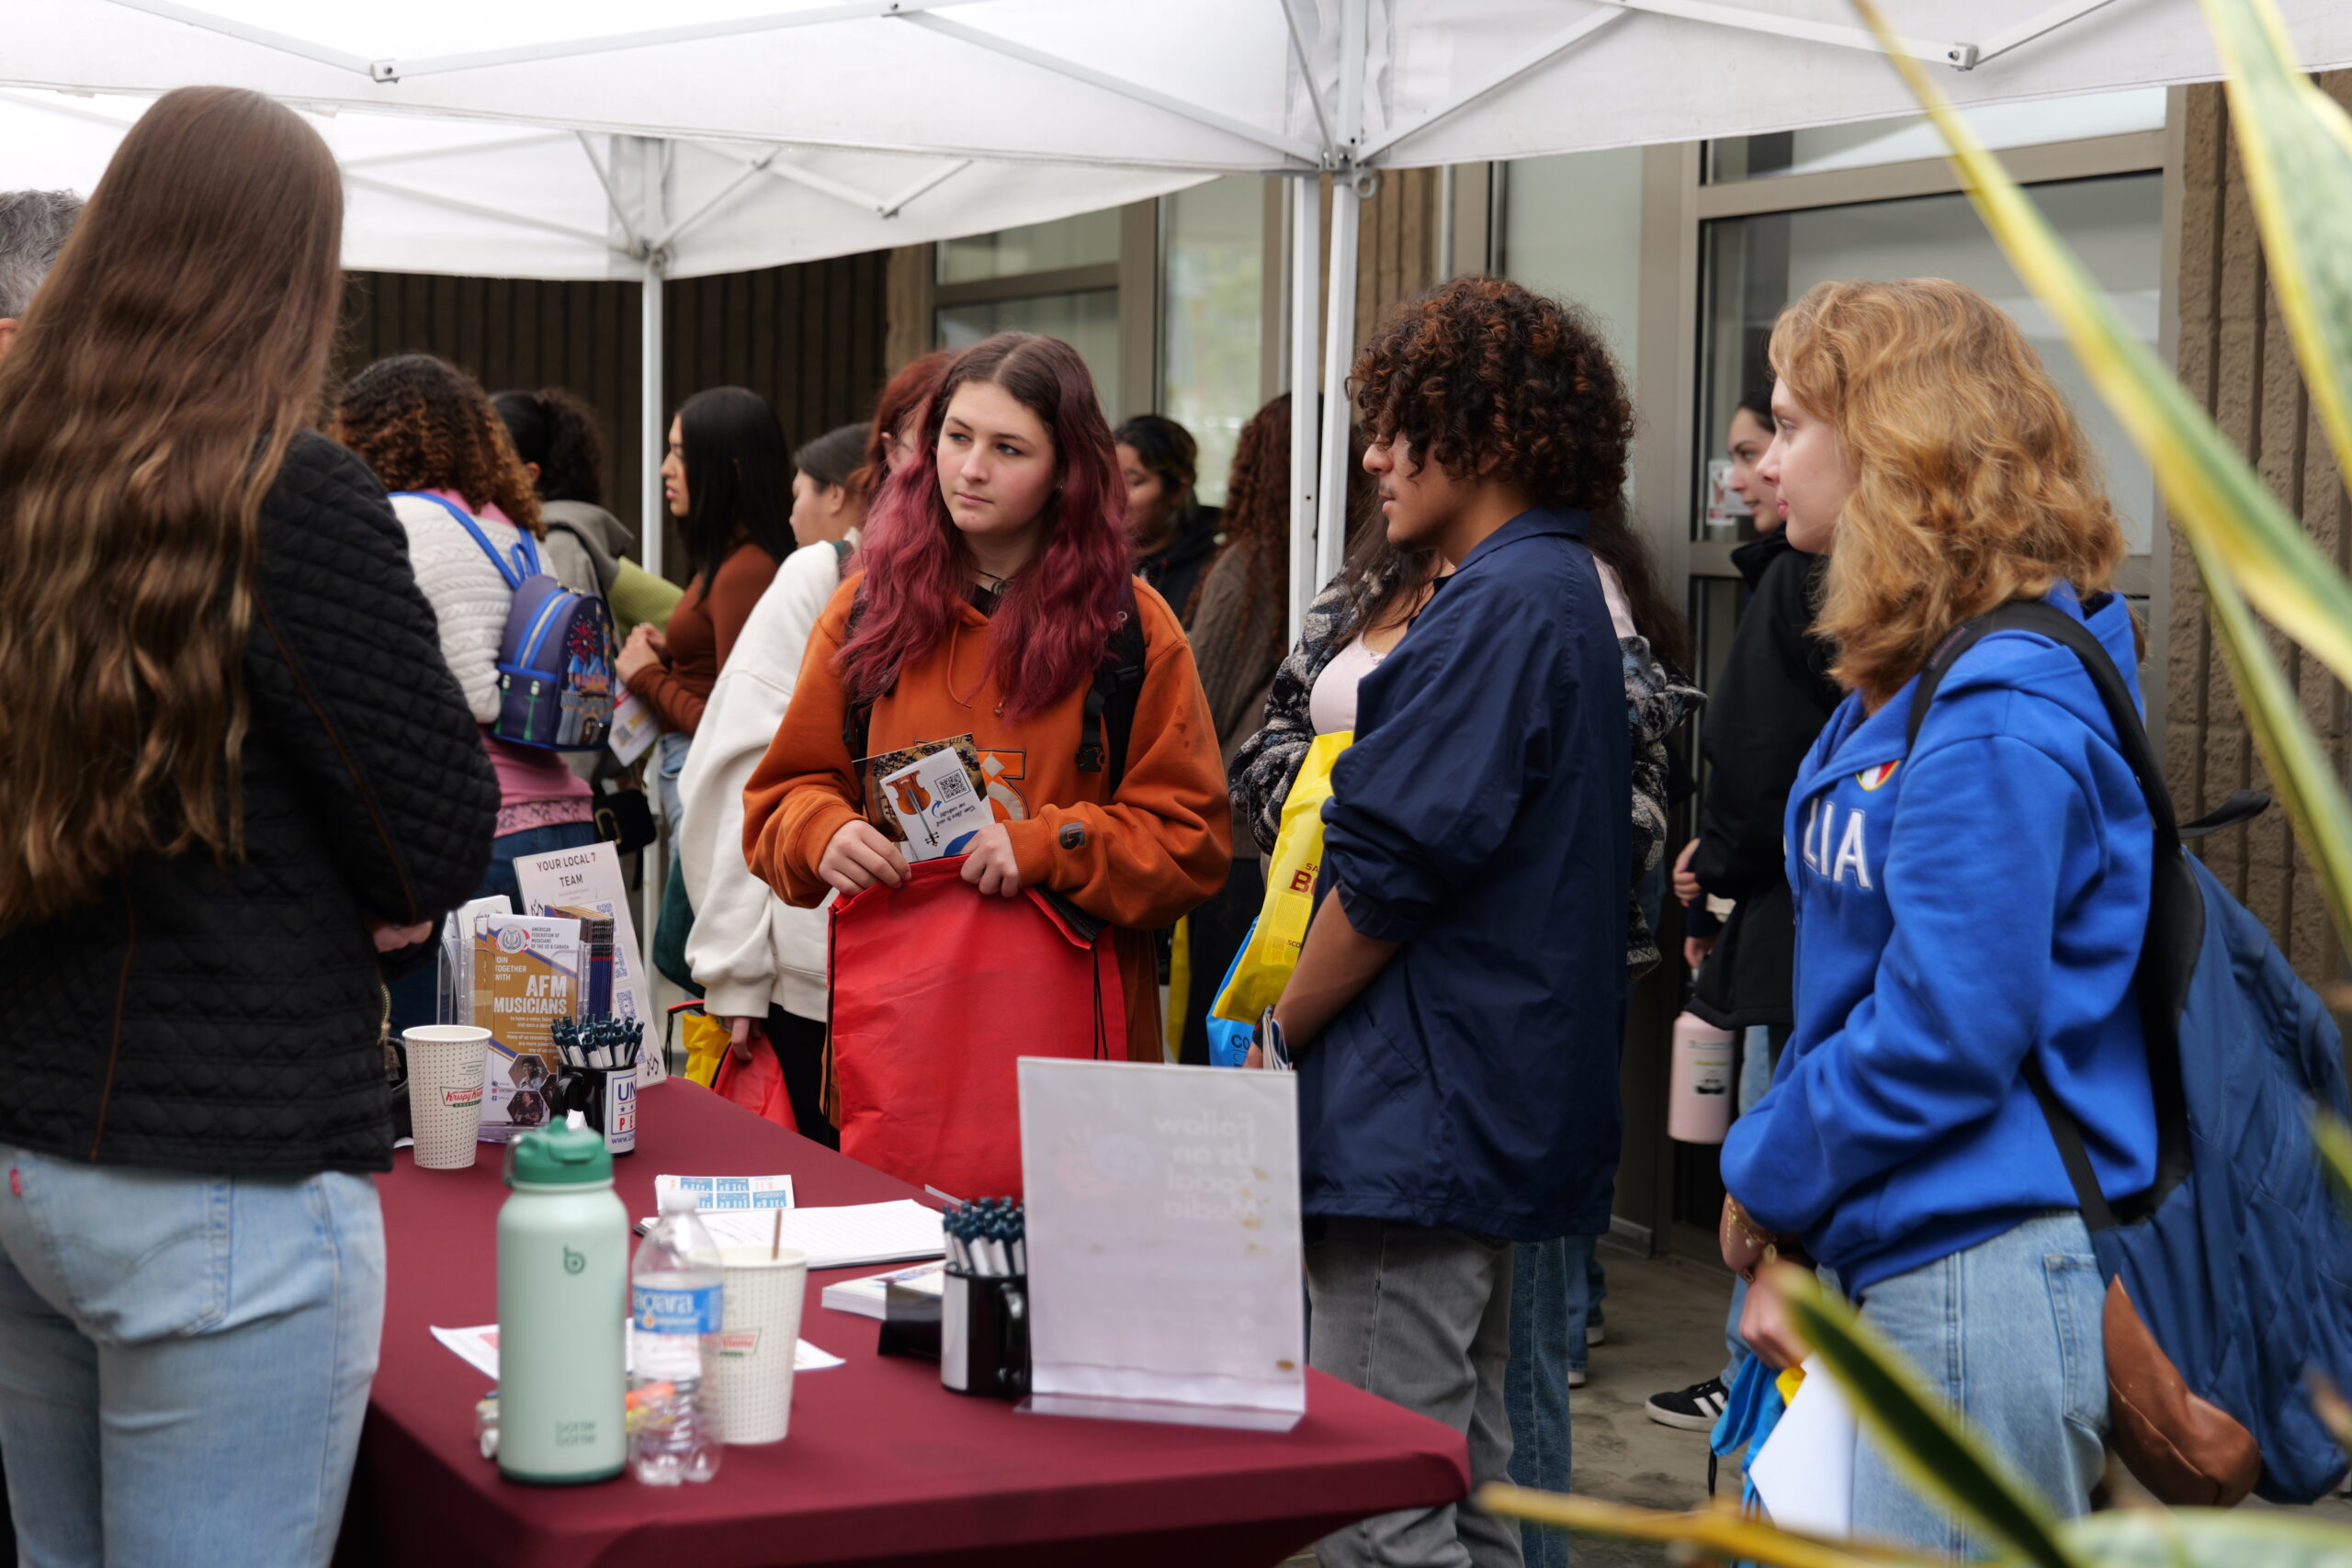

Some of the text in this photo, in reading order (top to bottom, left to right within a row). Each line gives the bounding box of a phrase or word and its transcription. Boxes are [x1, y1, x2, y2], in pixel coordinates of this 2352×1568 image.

[537, 852, 596, 872] YOUR LOCAL 7
[560, 874, 583, 887] TEAM
[526, 975, 567, 998] AFM
[493, 997, 567, 1014] MUSICIANS
[446, 1089, 472, 1102] Krispy
